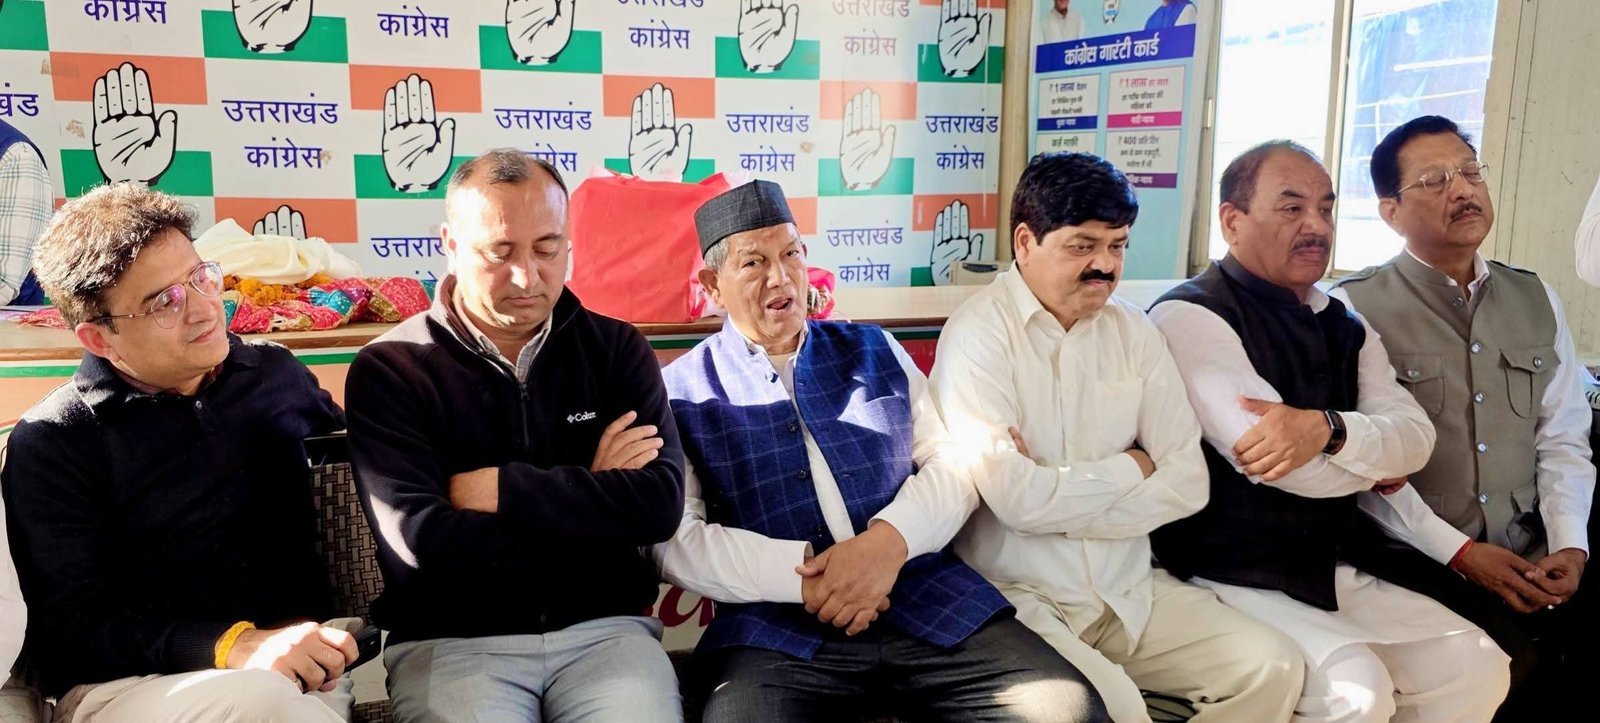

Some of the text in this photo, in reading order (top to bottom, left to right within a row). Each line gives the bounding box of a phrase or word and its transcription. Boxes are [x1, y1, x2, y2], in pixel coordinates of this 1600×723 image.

[377, 5, 450, 39] कांग्रेस
[628, 18, 691, 50] कांग्रेस
[843, 28, 897, 56] कांग्रेस
[1064, 31, 1160, 65] कांग्रेस गारंटी कार्ड
[222, 93, 339, 125] उत्तराखंड
[494, 102, 592, 131] उत्तराखंड
[726, 107, 809, 134] उत्तराखंड
[925, 108, 998, 133] उत्तराखंड
[244, 137, 323, 169] कांग्रेस
[740, 146, 796, 172] कांग्रेस
[936, 145, 985, 170] कांग्रेस
[826, 220, 904, 247] उत्तराखंड
[838, 258, 891, 283] कांग्रेस
